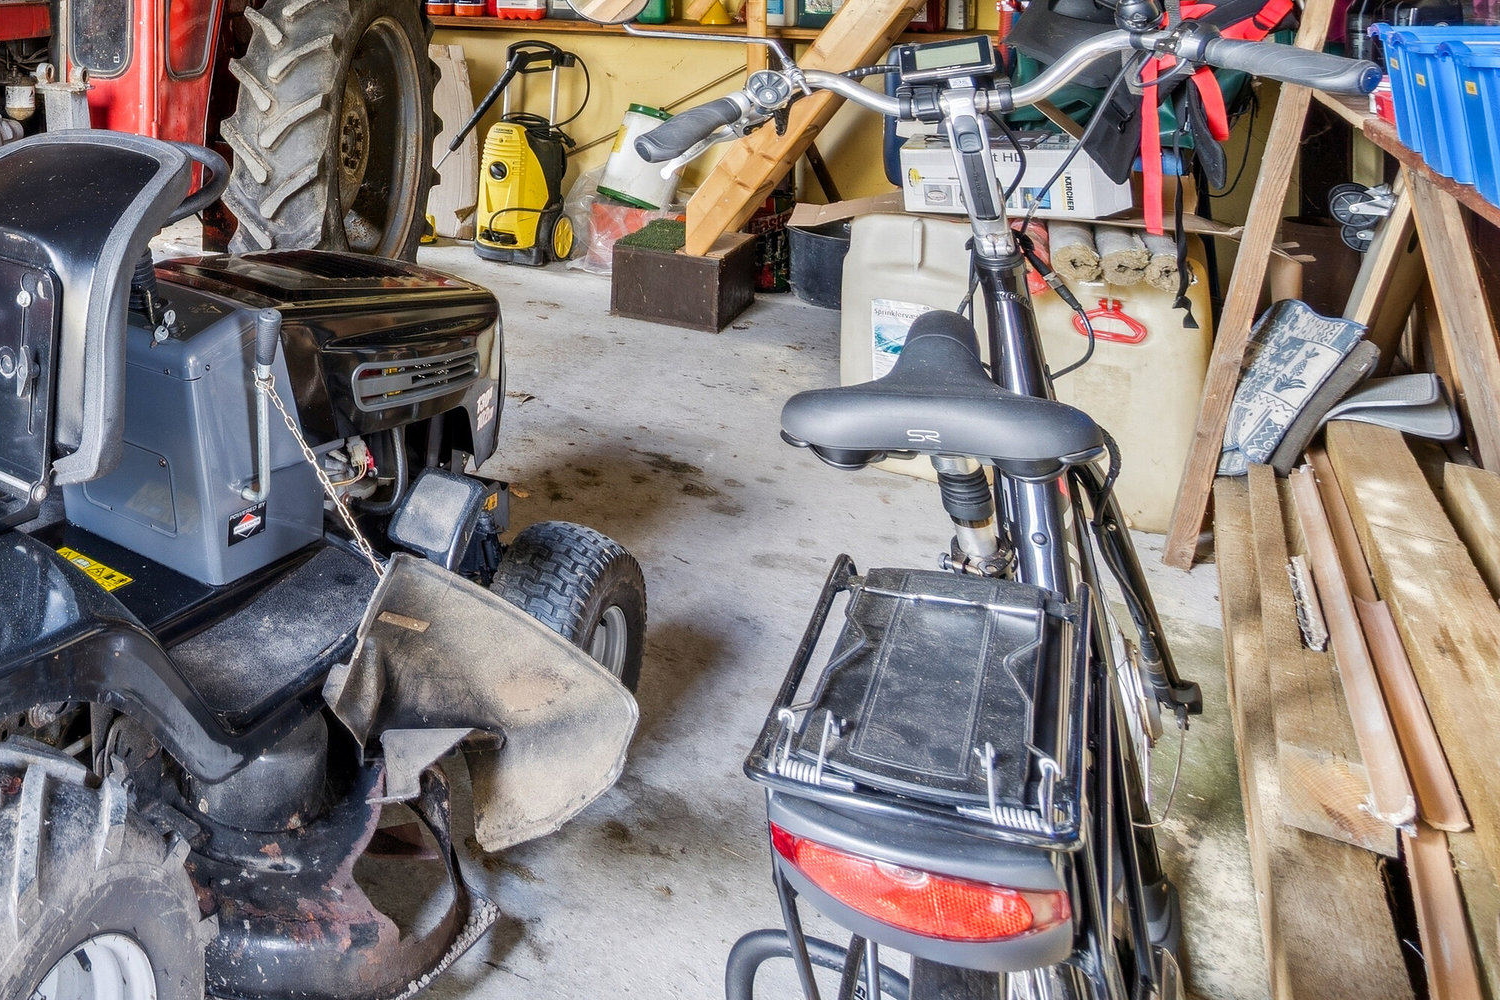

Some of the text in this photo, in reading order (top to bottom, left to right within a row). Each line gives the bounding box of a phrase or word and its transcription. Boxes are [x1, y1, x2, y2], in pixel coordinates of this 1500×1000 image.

[906, 429, 942, 443] SR
[230, 501, 266, 520] POWERED BY
